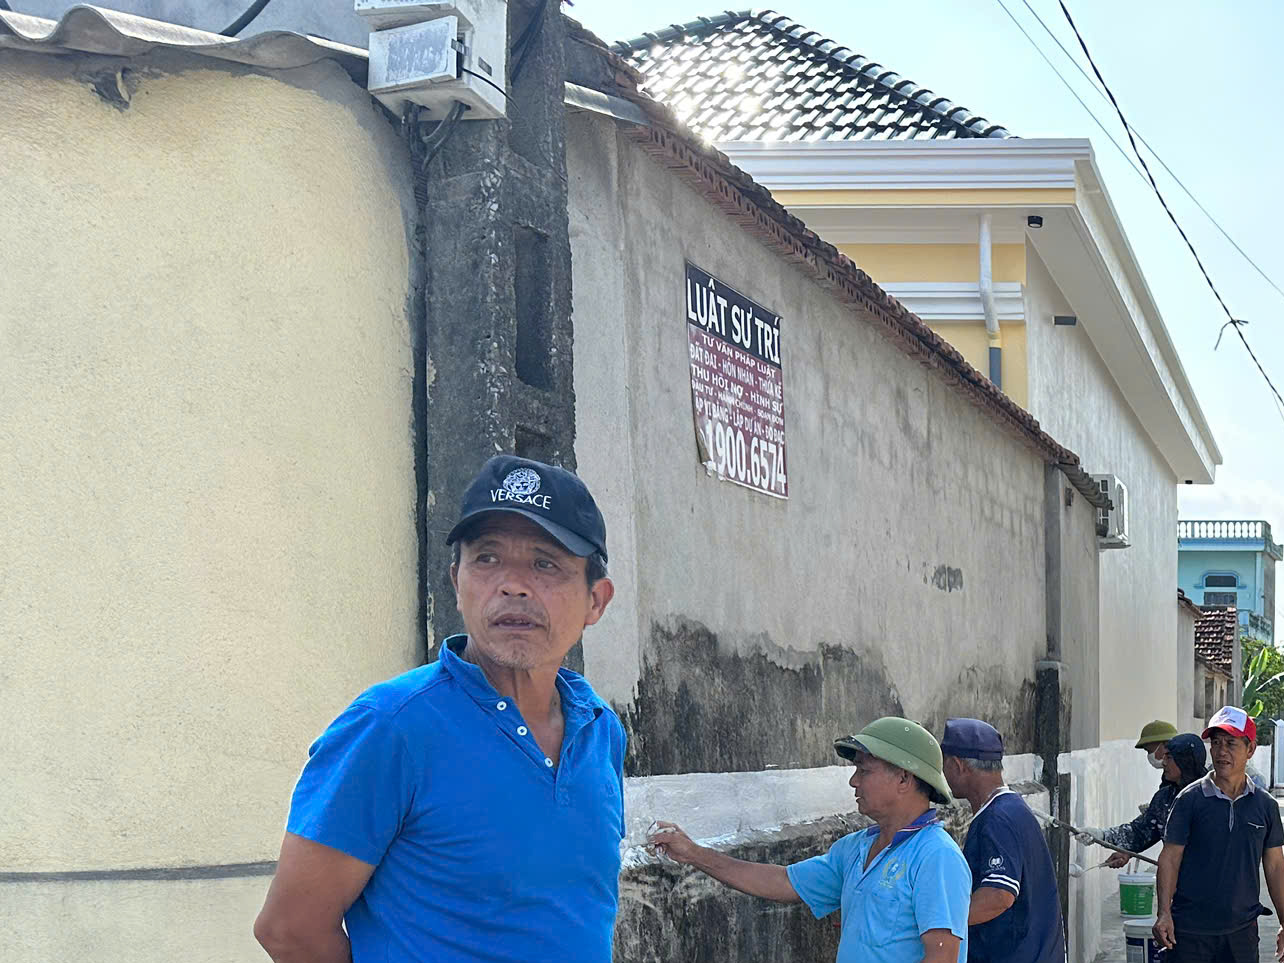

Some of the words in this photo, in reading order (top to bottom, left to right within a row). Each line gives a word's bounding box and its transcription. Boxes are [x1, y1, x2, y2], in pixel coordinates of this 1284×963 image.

[688, 279, 728, 336] LUẬT
[732, 305, 753, 349] SƯ
[756, 316, 780, 365] TRÍ
[702, 334, 714, 348] TƯ
[736, 352, 756, 368] PHÁP
[758, 363, 776, 379] LUẬT
[706, 351, 717, 369] ĐAI
[723, 359, 736, 376] HÔN
[692, 364, 710, 381] THU
[732, 384, 744, 398] NỢ
[751, 392, 770, 409] HÌNH
[773, 401, 784, 415] SỰ
[704, 420, 787, 494] 1900.6574
[490, 488, 552, 510] VERSACE
